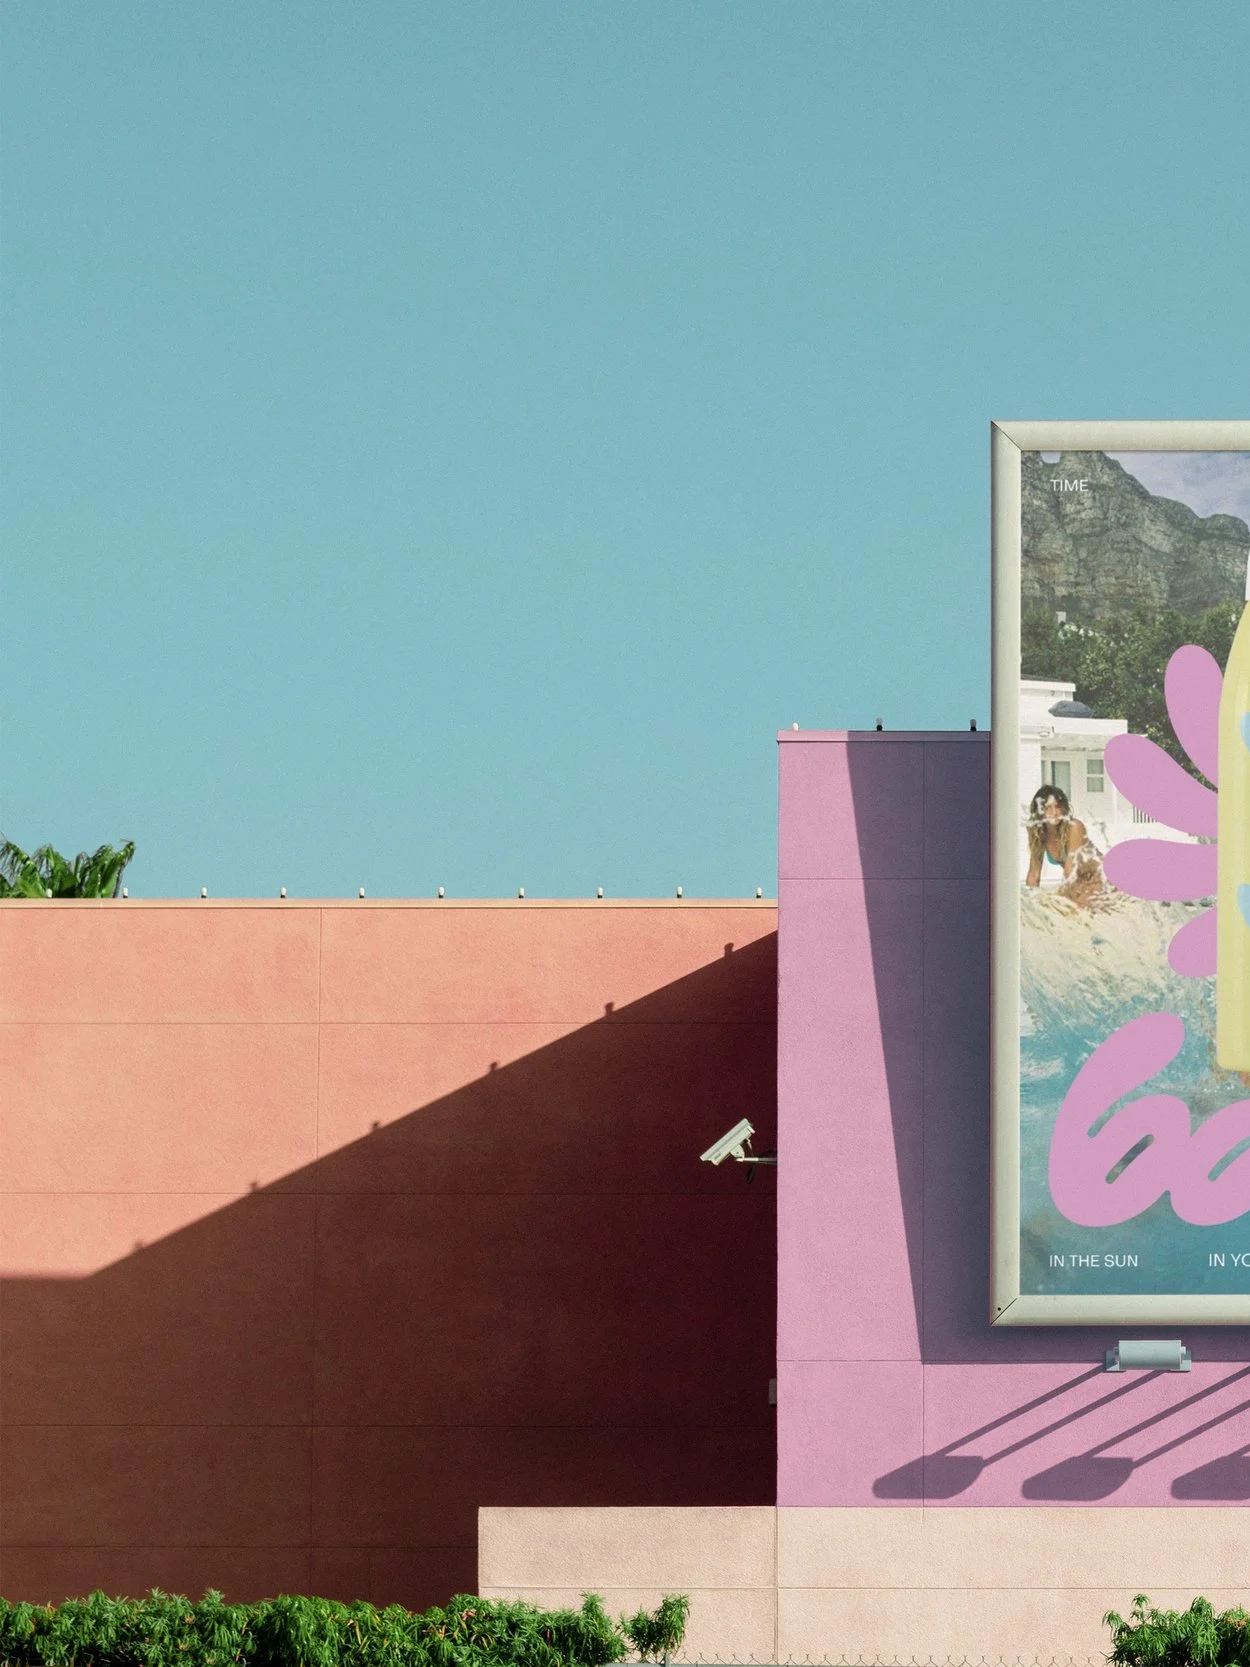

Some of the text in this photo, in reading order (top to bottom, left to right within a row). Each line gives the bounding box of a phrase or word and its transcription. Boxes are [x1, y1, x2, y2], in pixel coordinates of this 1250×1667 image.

[1050, 479, 1088, 492] TIME
[1049, 1254, 1138, 1268] IN THE SUN
[1209, 1253, 1225, 1268] IN
